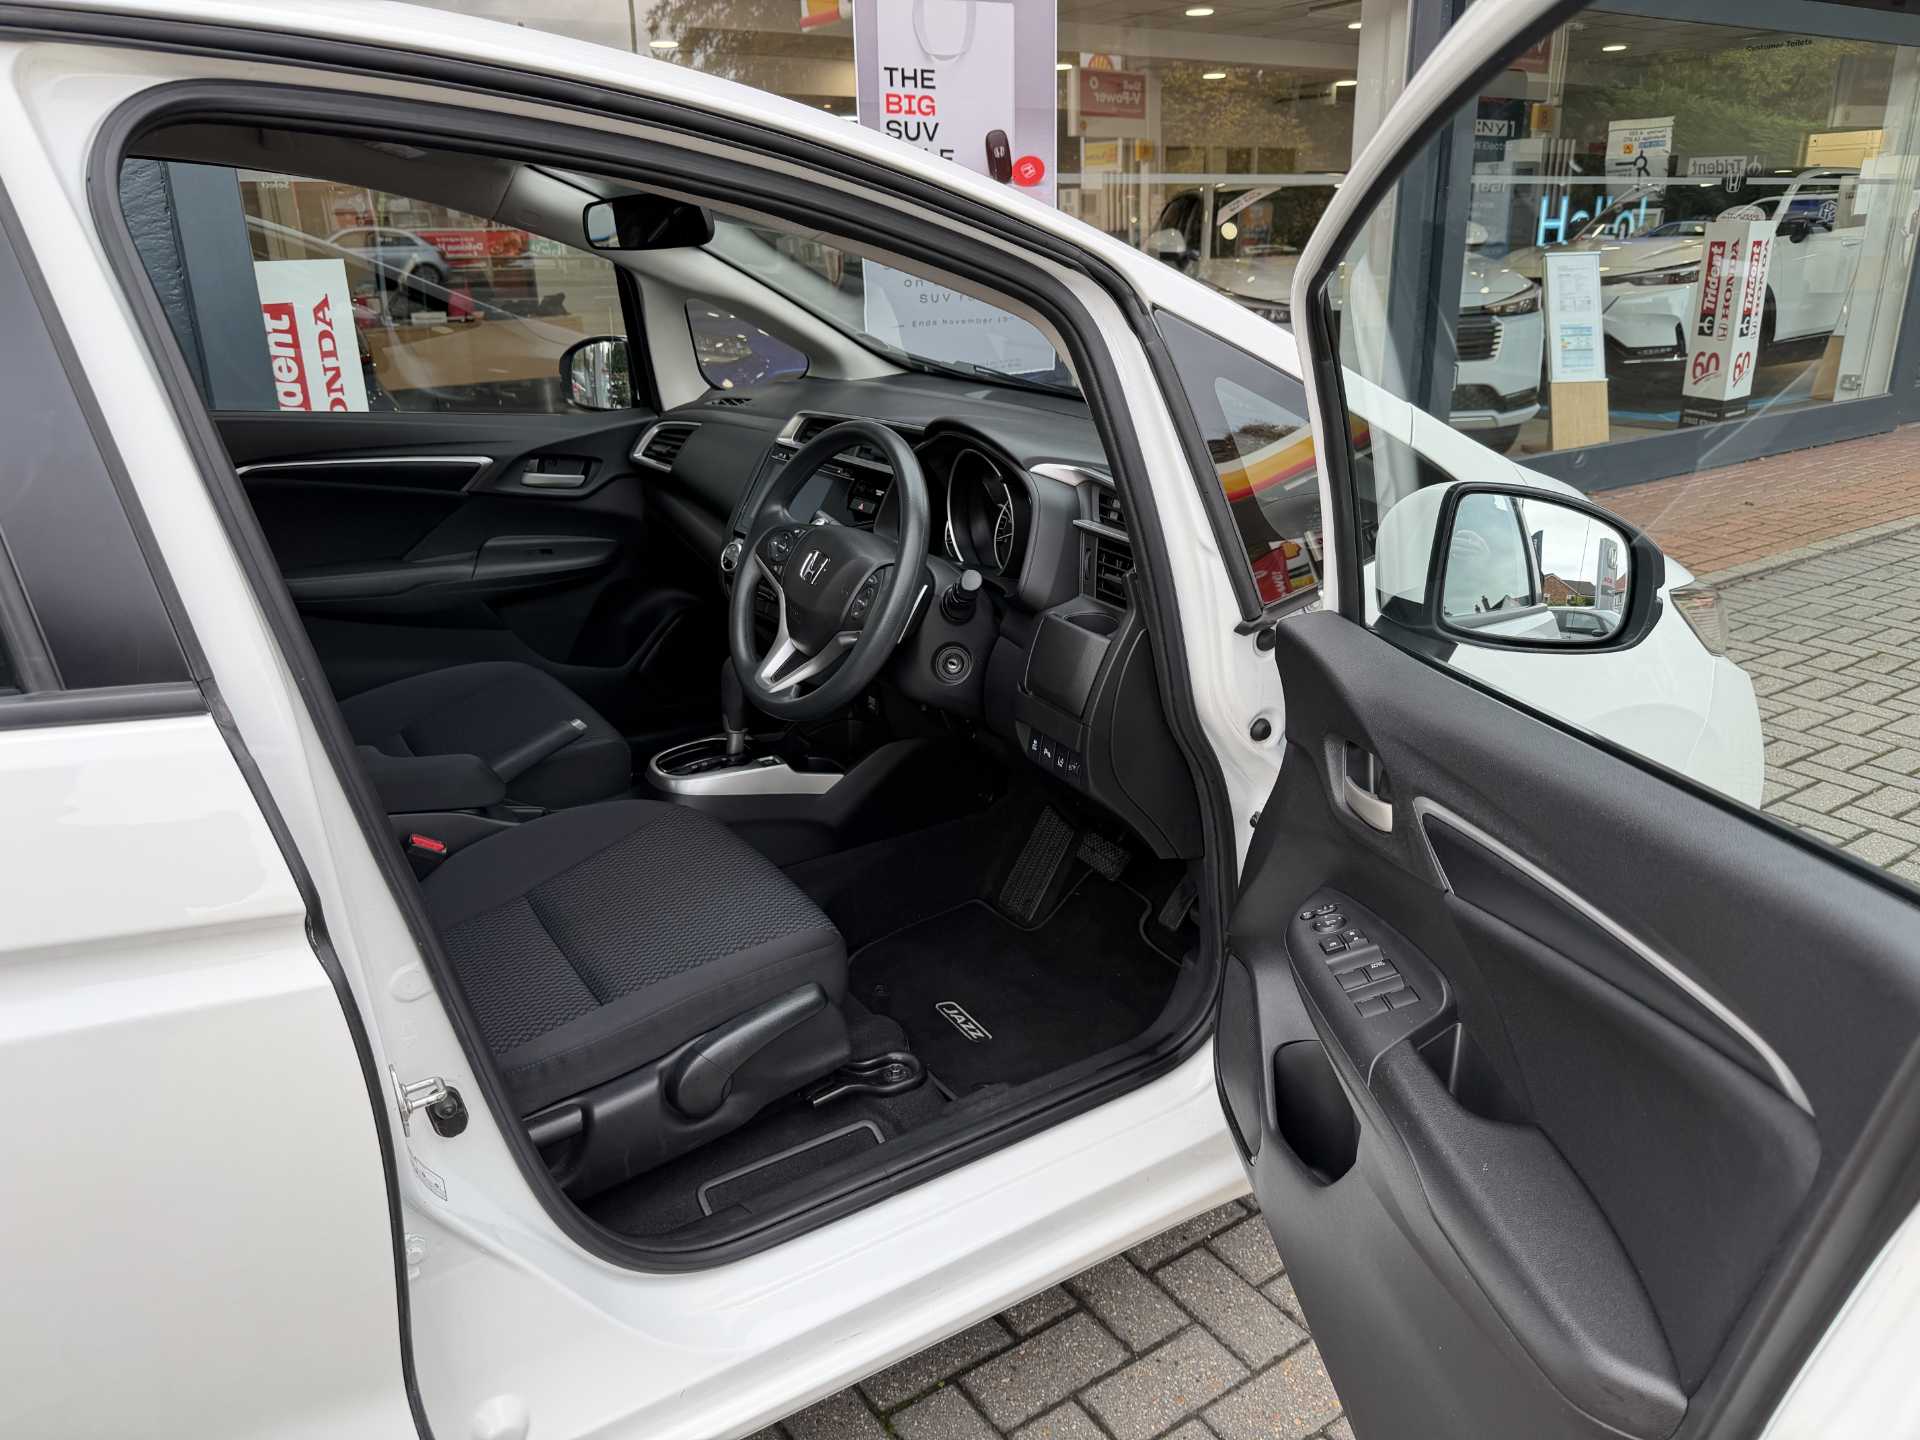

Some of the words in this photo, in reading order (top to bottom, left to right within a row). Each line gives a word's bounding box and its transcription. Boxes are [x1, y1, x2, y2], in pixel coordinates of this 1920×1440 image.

[1786, 39, 1813, 48] Toilets
[883, 66, 936, 90] THE
[885, 93, 936, 117] BIG
[885, 119, 940, 142] SUV
[1703, 242, 1725, 316] Trident
[1720, 239, 1740, 322] HONDA
[919, 293, 951, 304] SUV
[263, 311, 306, 411] dent
[312, 293, 349, 411] NDA
[942, 1007, 986, 1039] JAZZ
